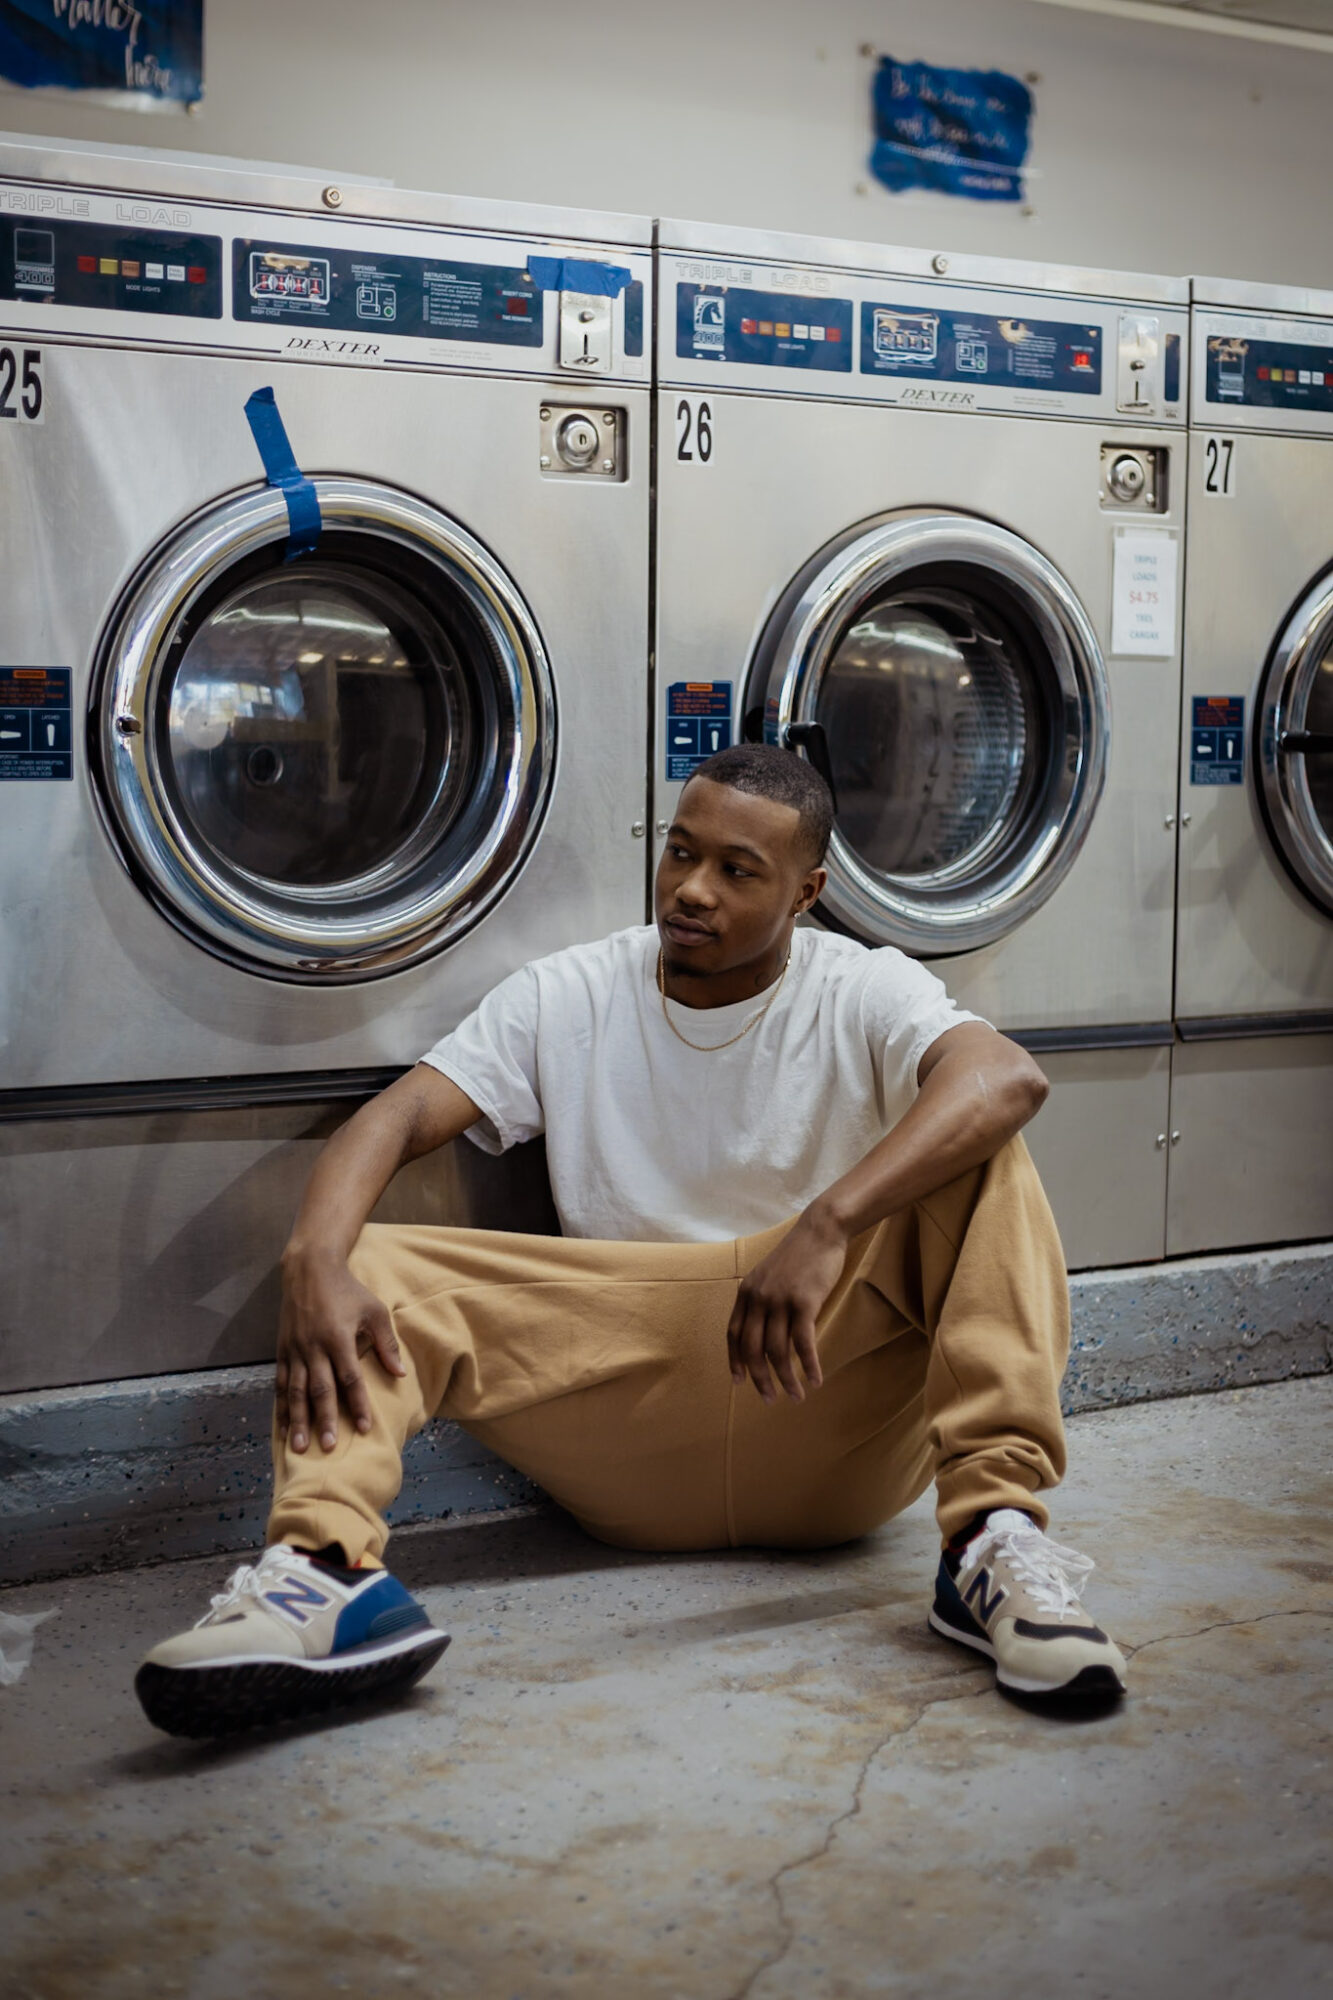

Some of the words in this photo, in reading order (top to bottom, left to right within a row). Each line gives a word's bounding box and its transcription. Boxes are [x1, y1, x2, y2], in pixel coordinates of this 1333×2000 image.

[0, 190, 90, 217] TRIPLE
[116, 203, 192, 228] LOAD
[14, 270, 55, 285] 400
[676, 262, 753, 283] TRIPLE
[771, 272, 833, 292] LOAD
[286, 337, 380, 355] DEXTER
[0, 347, 42, 420] 25
[901, 388, 975, 404] DEXTER
[677, 400, 712, 462] 26
[1206, 439, 1233, 493] 27
[1129, 591, 1159, 604] $4.75
